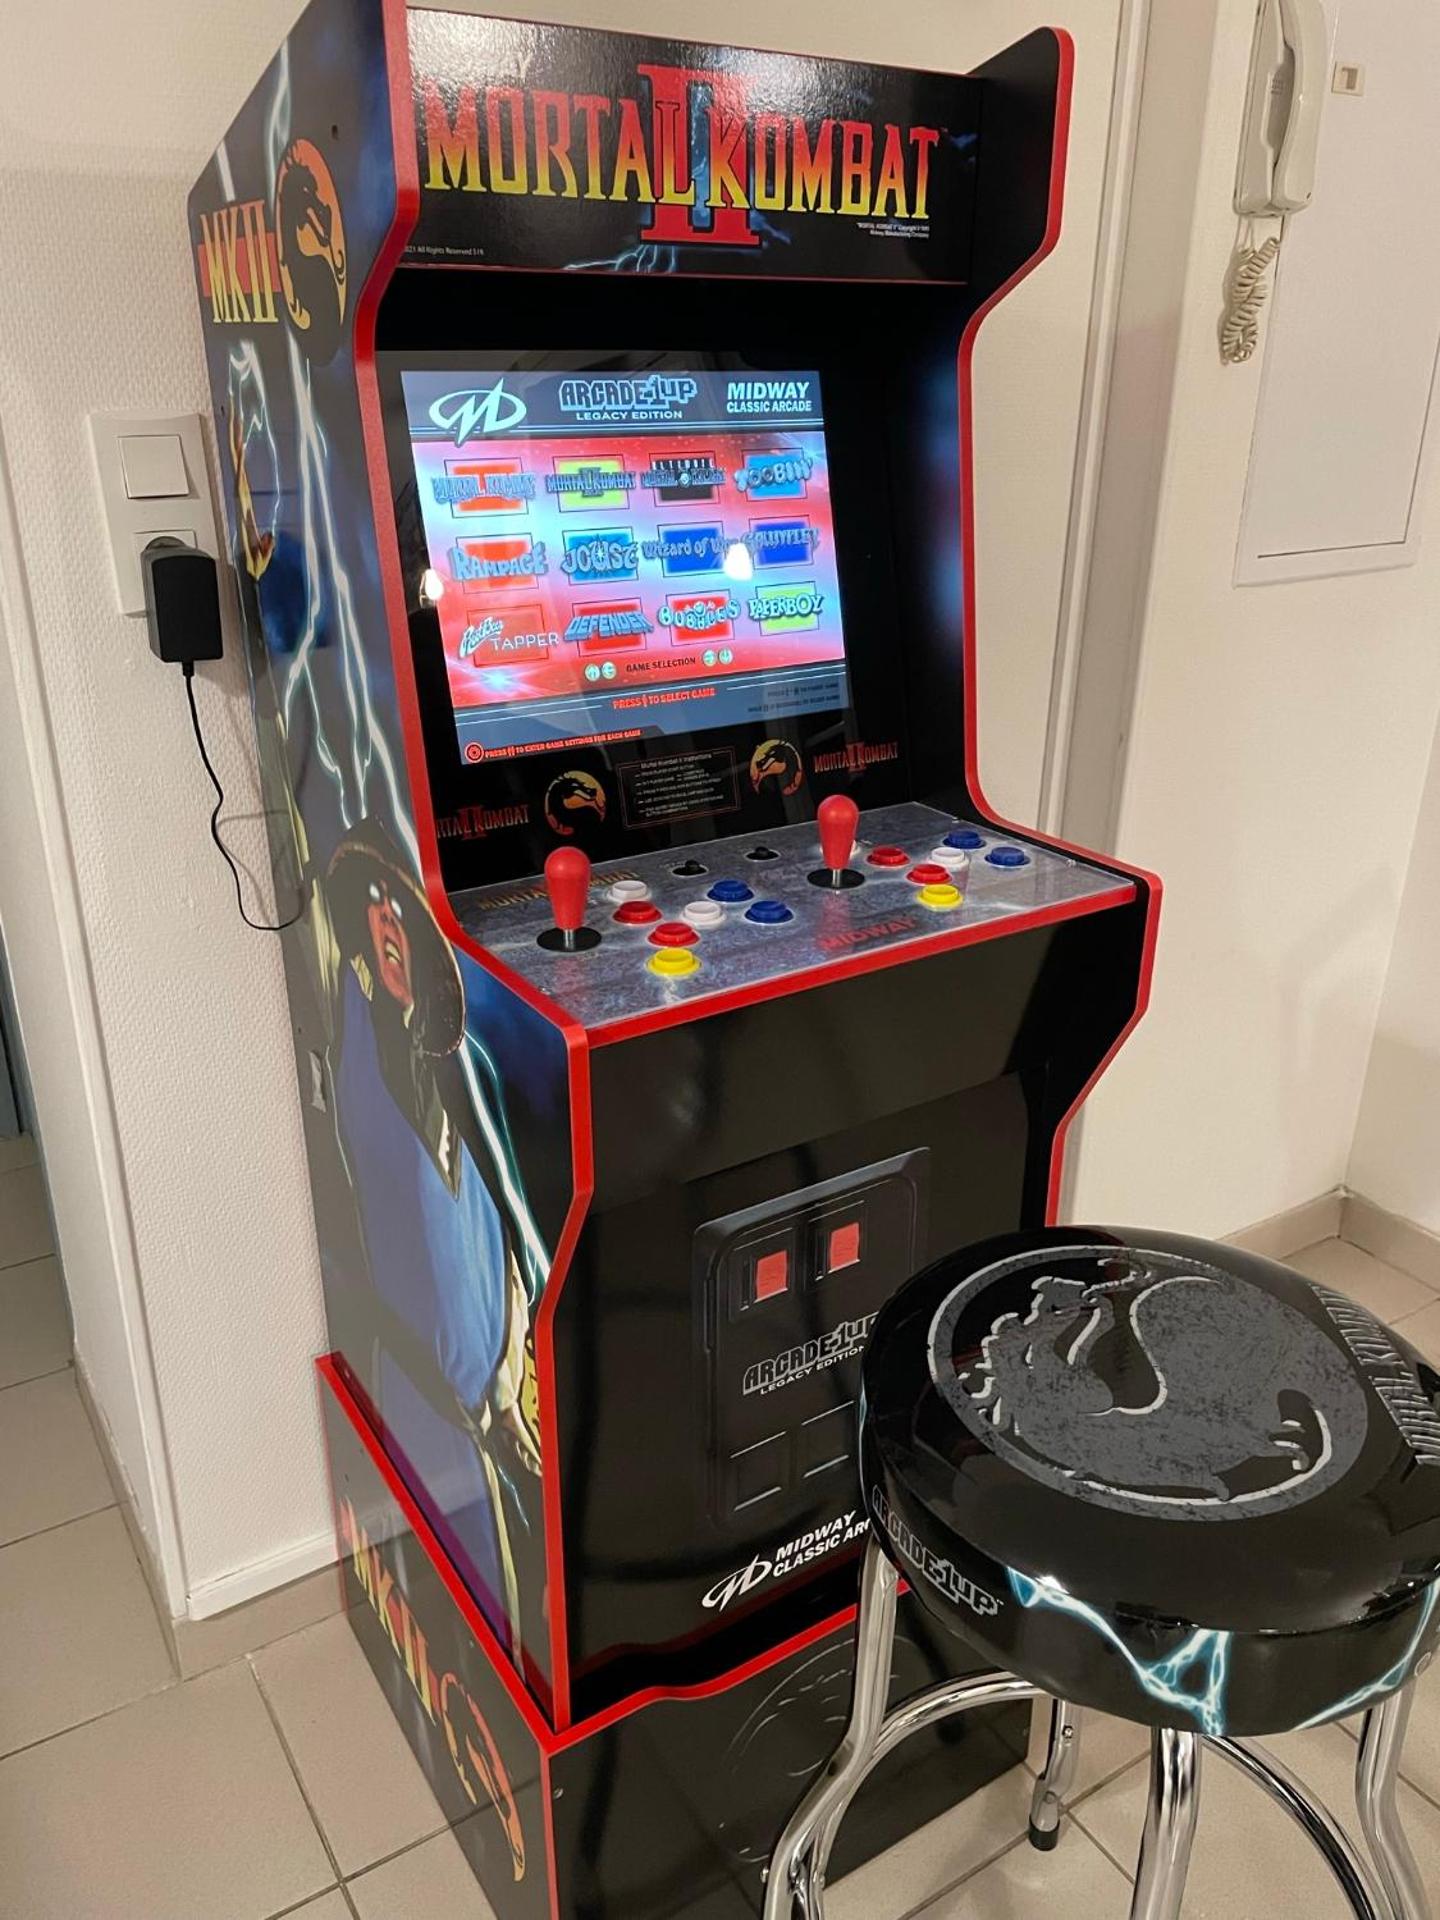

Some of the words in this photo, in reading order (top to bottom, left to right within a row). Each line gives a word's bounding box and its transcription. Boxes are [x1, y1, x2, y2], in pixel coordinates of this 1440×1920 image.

[422, 76, 696, 206] MORTAL
[704, 105, 941, 219] KOMBAT
[727, 382, 810, 400] MIDWAY
[576, 411, 628, 420] LEGACY
[632, 410, 683, 420] EDITION
[727, 401, 770, 413] CLASSIC
[771, 400, 812, 412] ARCADE
[448, 542, 548, 582] RAMPAGE
[561, 537, 639, 574] JOUST
[642, 538, 693, 560] Wizard
[693, 536, 709, 558] of
[748, 592, 826, 621] PAPERBOY
[563, 610, 655, 642] DEFENDER
[490, 631, 561, 652] TAPPER
[626, 661, 650, 673] GAME
[652, 657, 696, 669] SELECTION
[613, 697, 642, 709] PRESS
[648, 694, 660, 705] TO
[660, 690, 691, 703] SELECT
[691, 687, 716, 699] GAME
[856, 742, 899, 765] KOMBAT
[437, 810, 472, 838] RTAL
[474, 804, 529, 832] KOMBAT
[821, 915, 915, 950] MIDWAY
[760, 1366, 813, 1395] LEGACY
[775, 1510, 857, 1562] MIDWAY
[772, 1533, 841, 1578] CLASSIC
